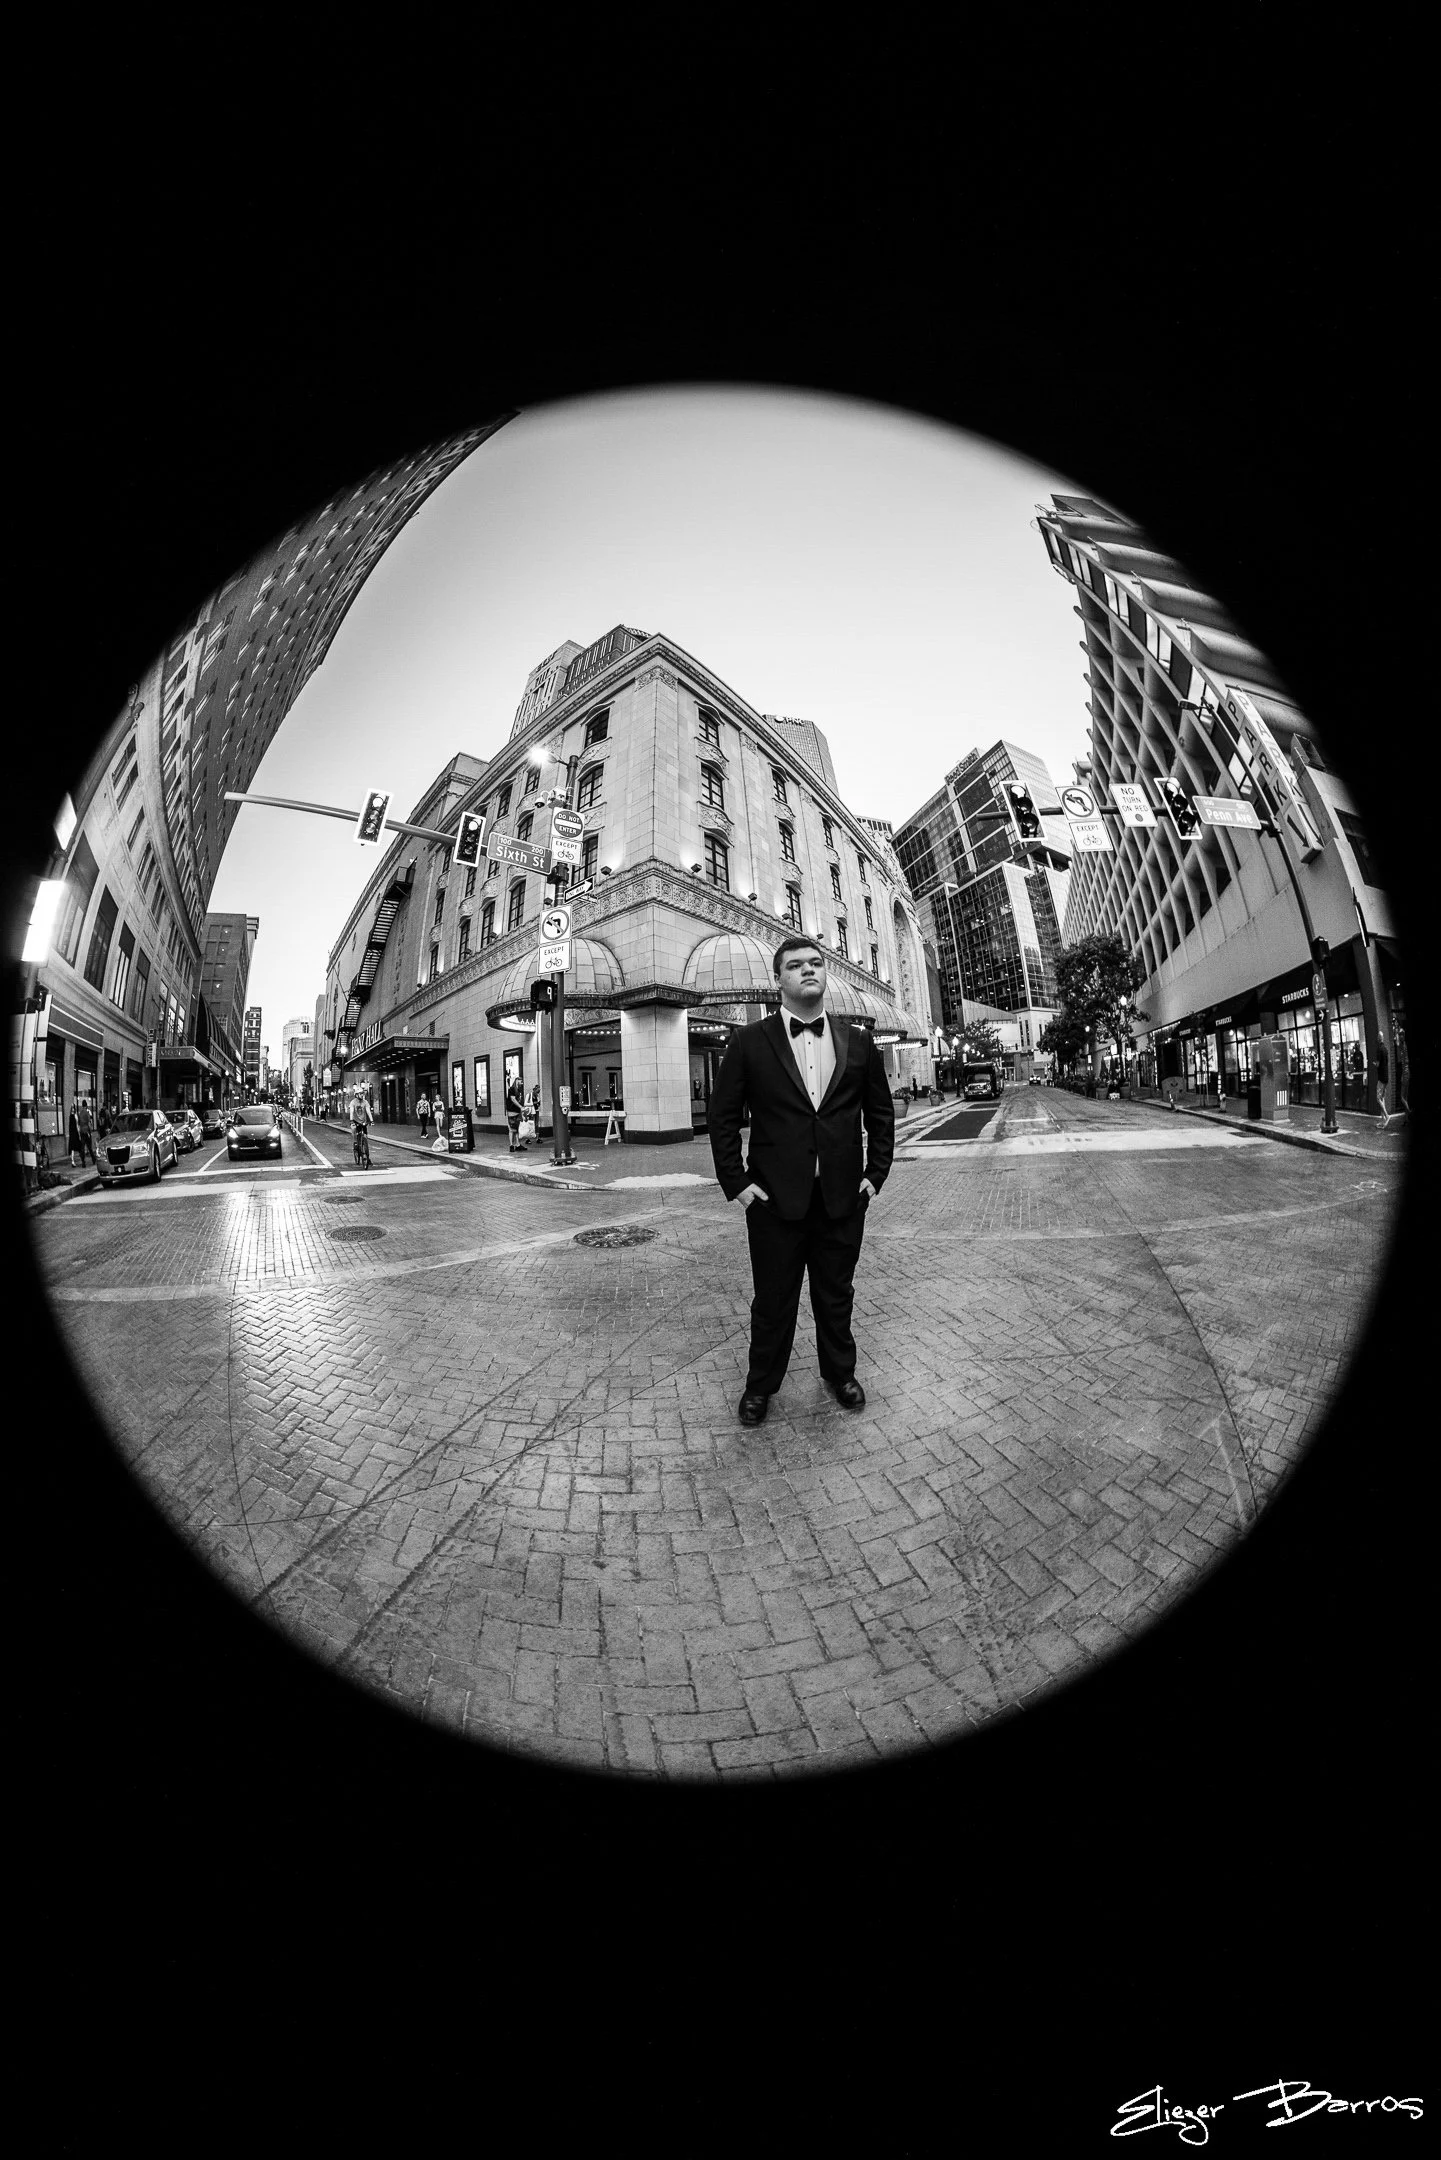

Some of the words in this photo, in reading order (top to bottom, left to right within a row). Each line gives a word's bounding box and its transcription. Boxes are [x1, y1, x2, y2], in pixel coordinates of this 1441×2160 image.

[1236, 694, 1303, 798] PARK
[1228, 701, 1288, 806] PARK
[1120, 787, 1134, 795] NO
[568, 815, 580, 823] NOT
[1205, 808, 1233, 821] Penn
[1235, 811, 1254, 824] Ave
[559, 825, 577, 835] ENTER
[1077, 824, 1099, 832] EXCEPT
[500, 837, 512, 846] 100
[555, 840, 578, 850] EXCEPT
[531, 846, 544, 855] 200
[495, 846, 528, 864] Sixth
[532, 856, 545, 869] St
[543, 945, 565, 956] EXCEPT
[547, 986, 553, 1003] 9
[1281, 987, 1310, 1004] STARBUCKS
[366, 1020, 382, 1048] HALL
